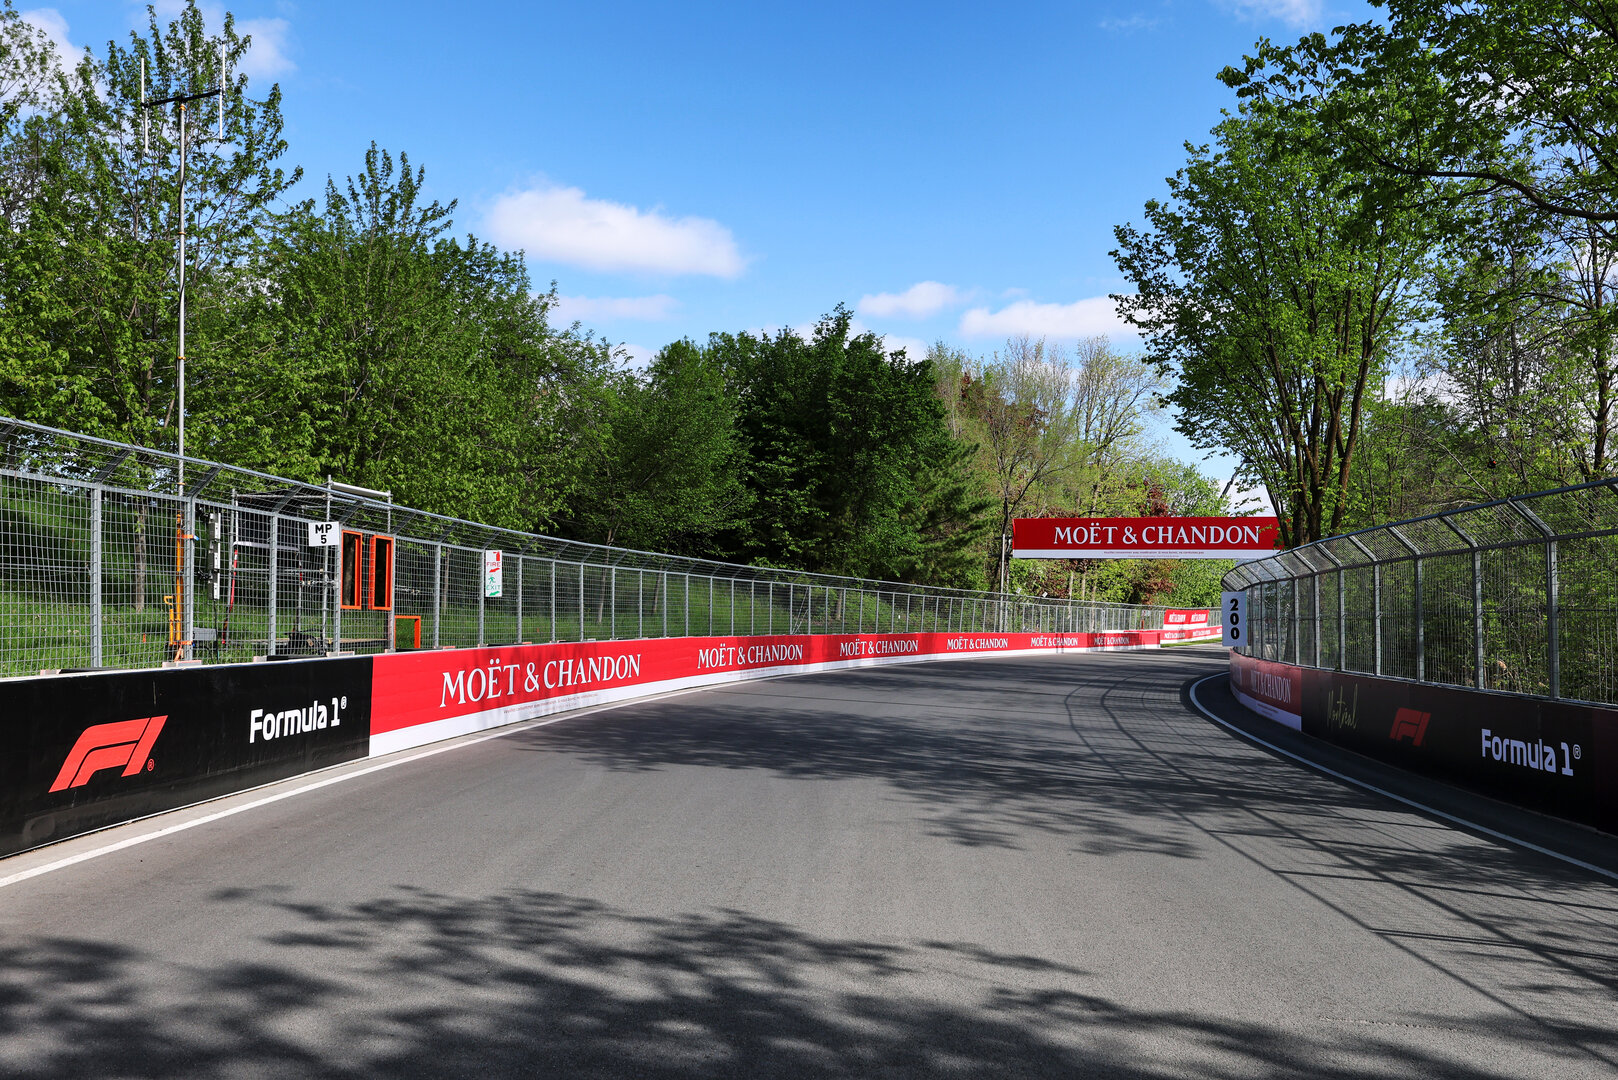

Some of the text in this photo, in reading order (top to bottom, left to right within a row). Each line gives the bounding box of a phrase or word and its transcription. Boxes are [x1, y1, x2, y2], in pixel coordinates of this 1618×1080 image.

[315, 524, 332, 534] MP
[321, 535, 327, 544] 5
[1053, 522, 1260, 545] MOËT & CHANDON
[840, 639, 918, 657] MOËT & CHANDON
[947, 636, 1008, 650] MOËT & CHANDON
[697, 643, 803, 669] MOËT & CHANDON
[440, 658, 520, 708] MOËT
[524, 662, 540, 694] &
[543, 654, 641, 689] CHANDON
[250, 700, 327, 744] Formula
[1481, 728, 1557, 773] Formula
